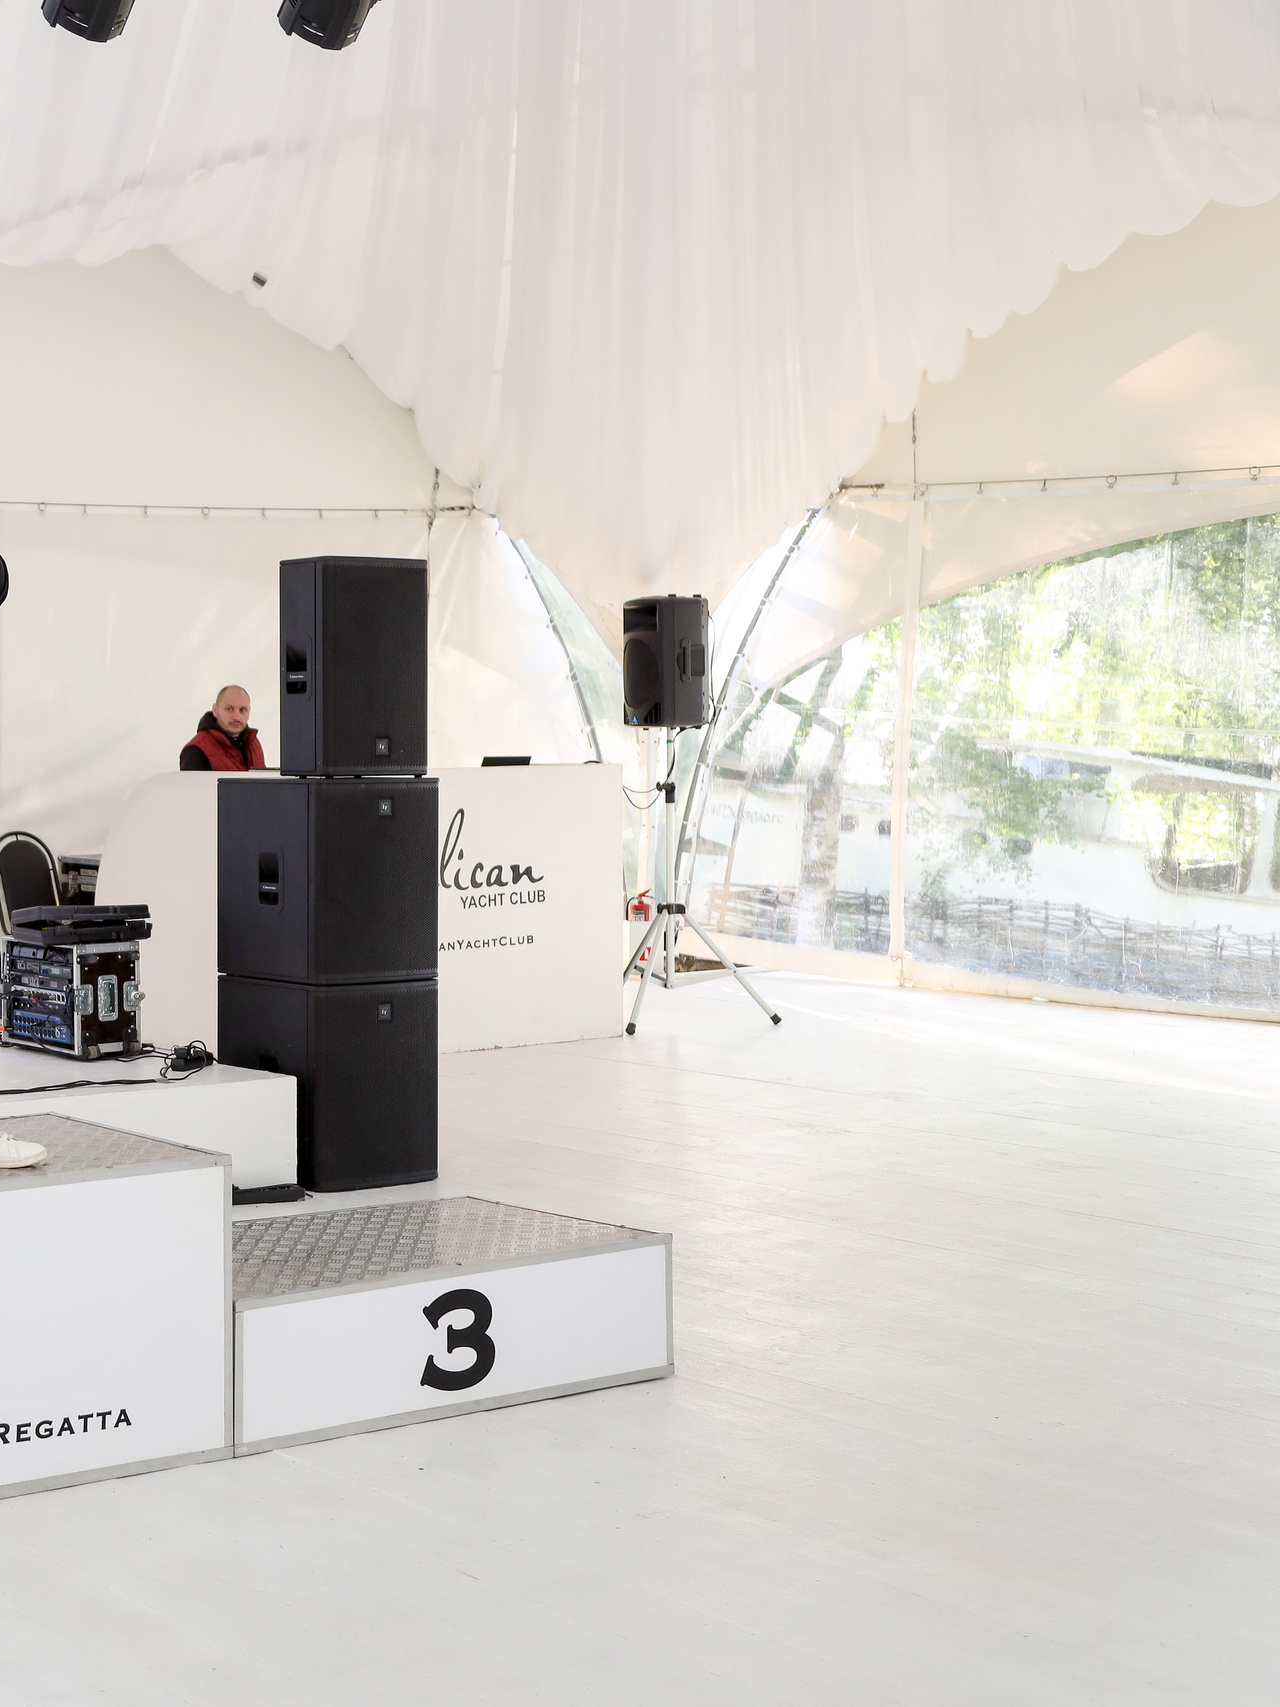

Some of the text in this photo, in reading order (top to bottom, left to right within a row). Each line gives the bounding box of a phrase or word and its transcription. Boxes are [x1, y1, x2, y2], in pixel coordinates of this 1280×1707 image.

[438, 808, 544, 890] lican
[460, 890, 546, 909] YACHT CLUB
[439, 935, 534, 951] ANYACHTCLUB
[420, 1289, 496, 1391] 3
